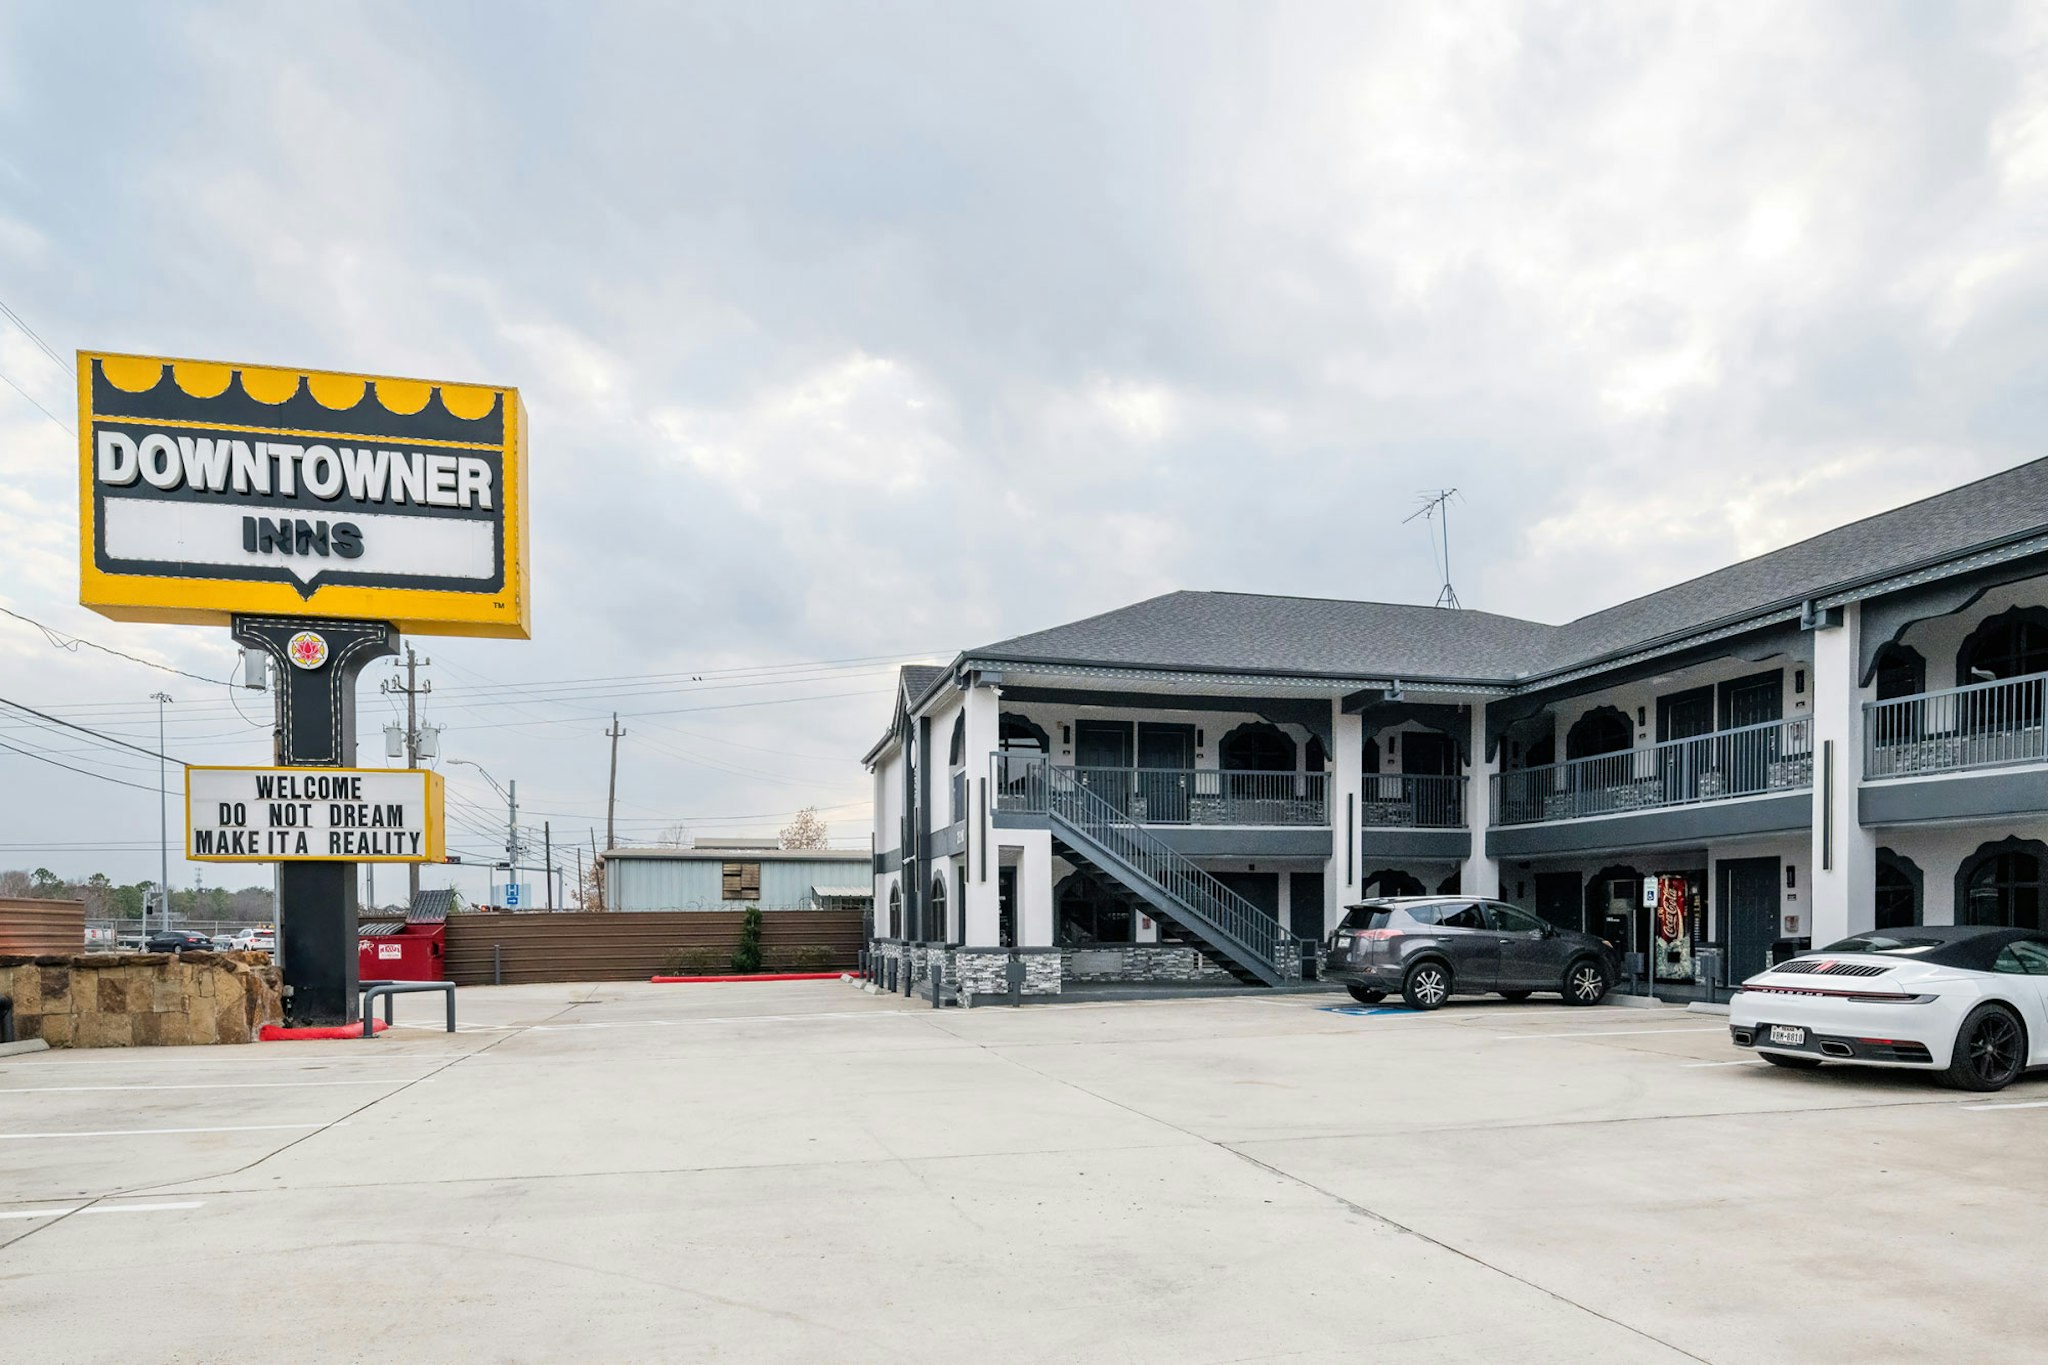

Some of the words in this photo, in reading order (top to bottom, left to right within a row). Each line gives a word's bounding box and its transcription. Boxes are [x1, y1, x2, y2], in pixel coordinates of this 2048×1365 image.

[98, 430, 494, 510] DOWNTOWNER
[242, 516, 364, 559] INNS
[492, 601, 505, 609] TM
[255, 775, 362, 800] WELCOME
[219, 802, 246, 827] DO
[269, 803, 312, 827] NOT
[329, 804, 404, 828] DREAM
[195, 830, 259, 855] MAKE
[329, 831, 421, 855] REALITY
